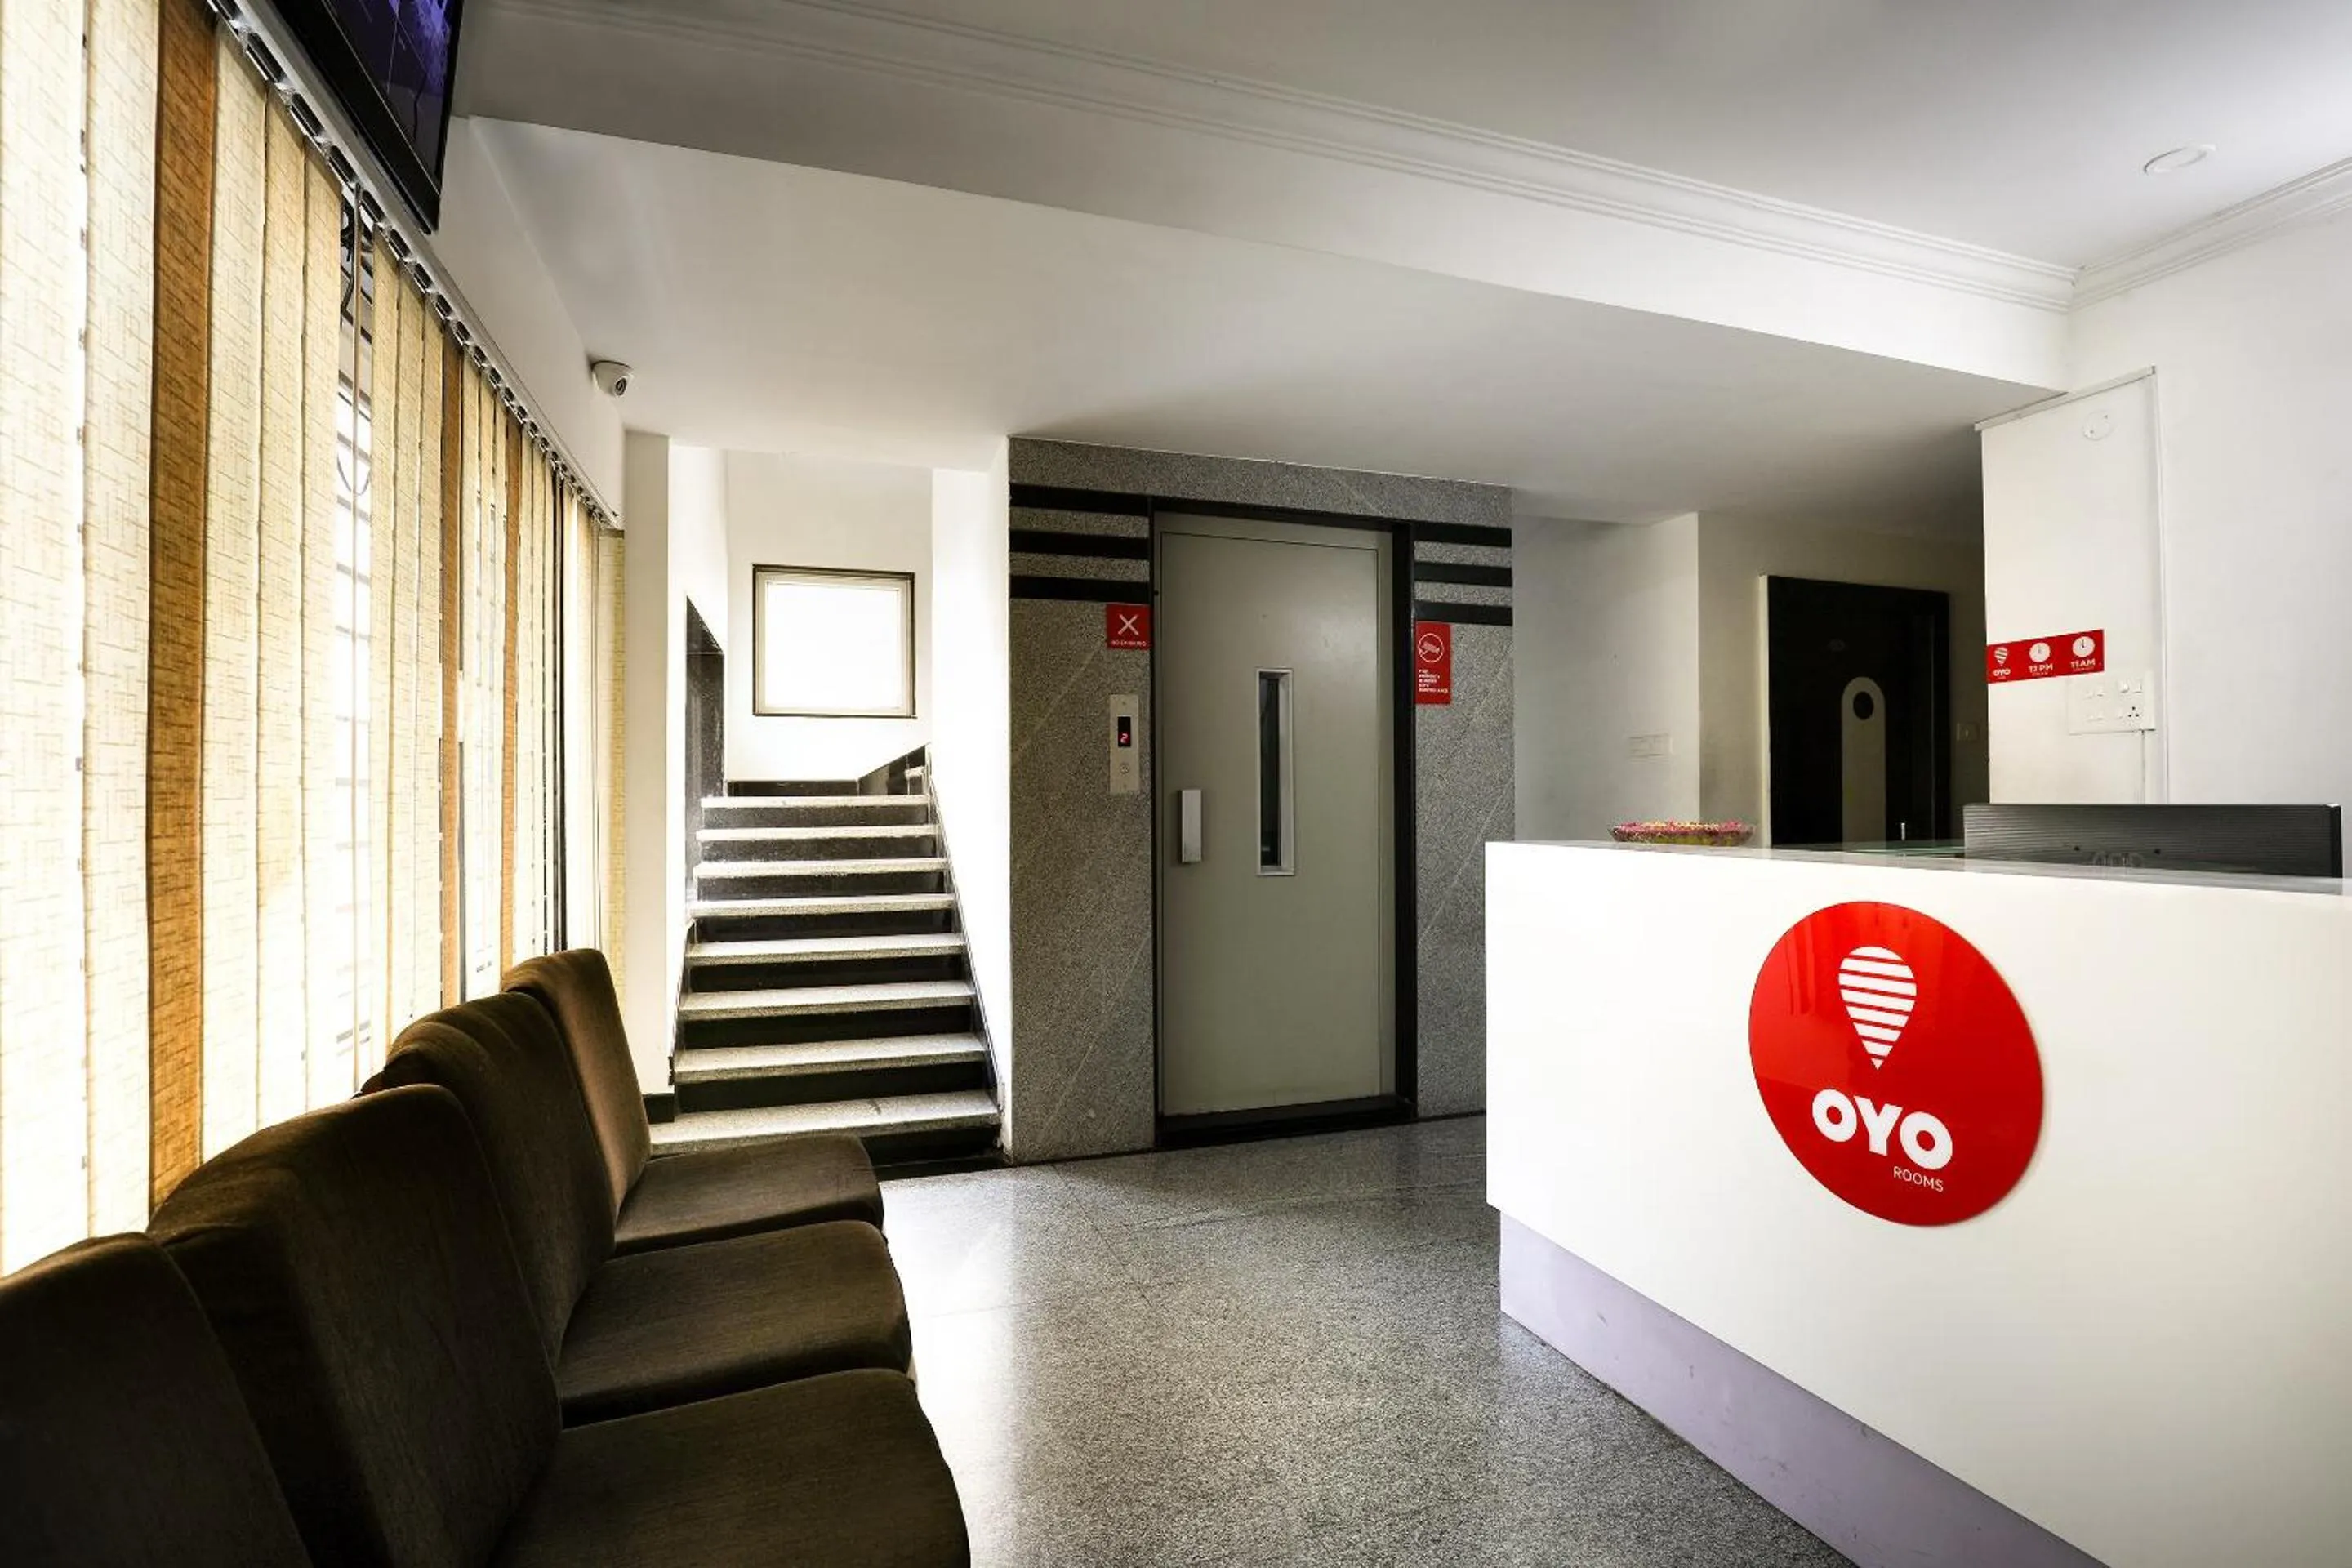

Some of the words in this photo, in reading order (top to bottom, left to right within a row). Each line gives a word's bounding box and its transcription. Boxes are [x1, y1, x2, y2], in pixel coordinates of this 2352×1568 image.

[2080, 658, 2096, 667] AM
[1993, 668, 2011, 676] OYO
[2039, 663, 2053, 672] PM
[1811, 1088, 1953, 1170] OYO
[1893, 1166, 1944, 1192] ROOMS
